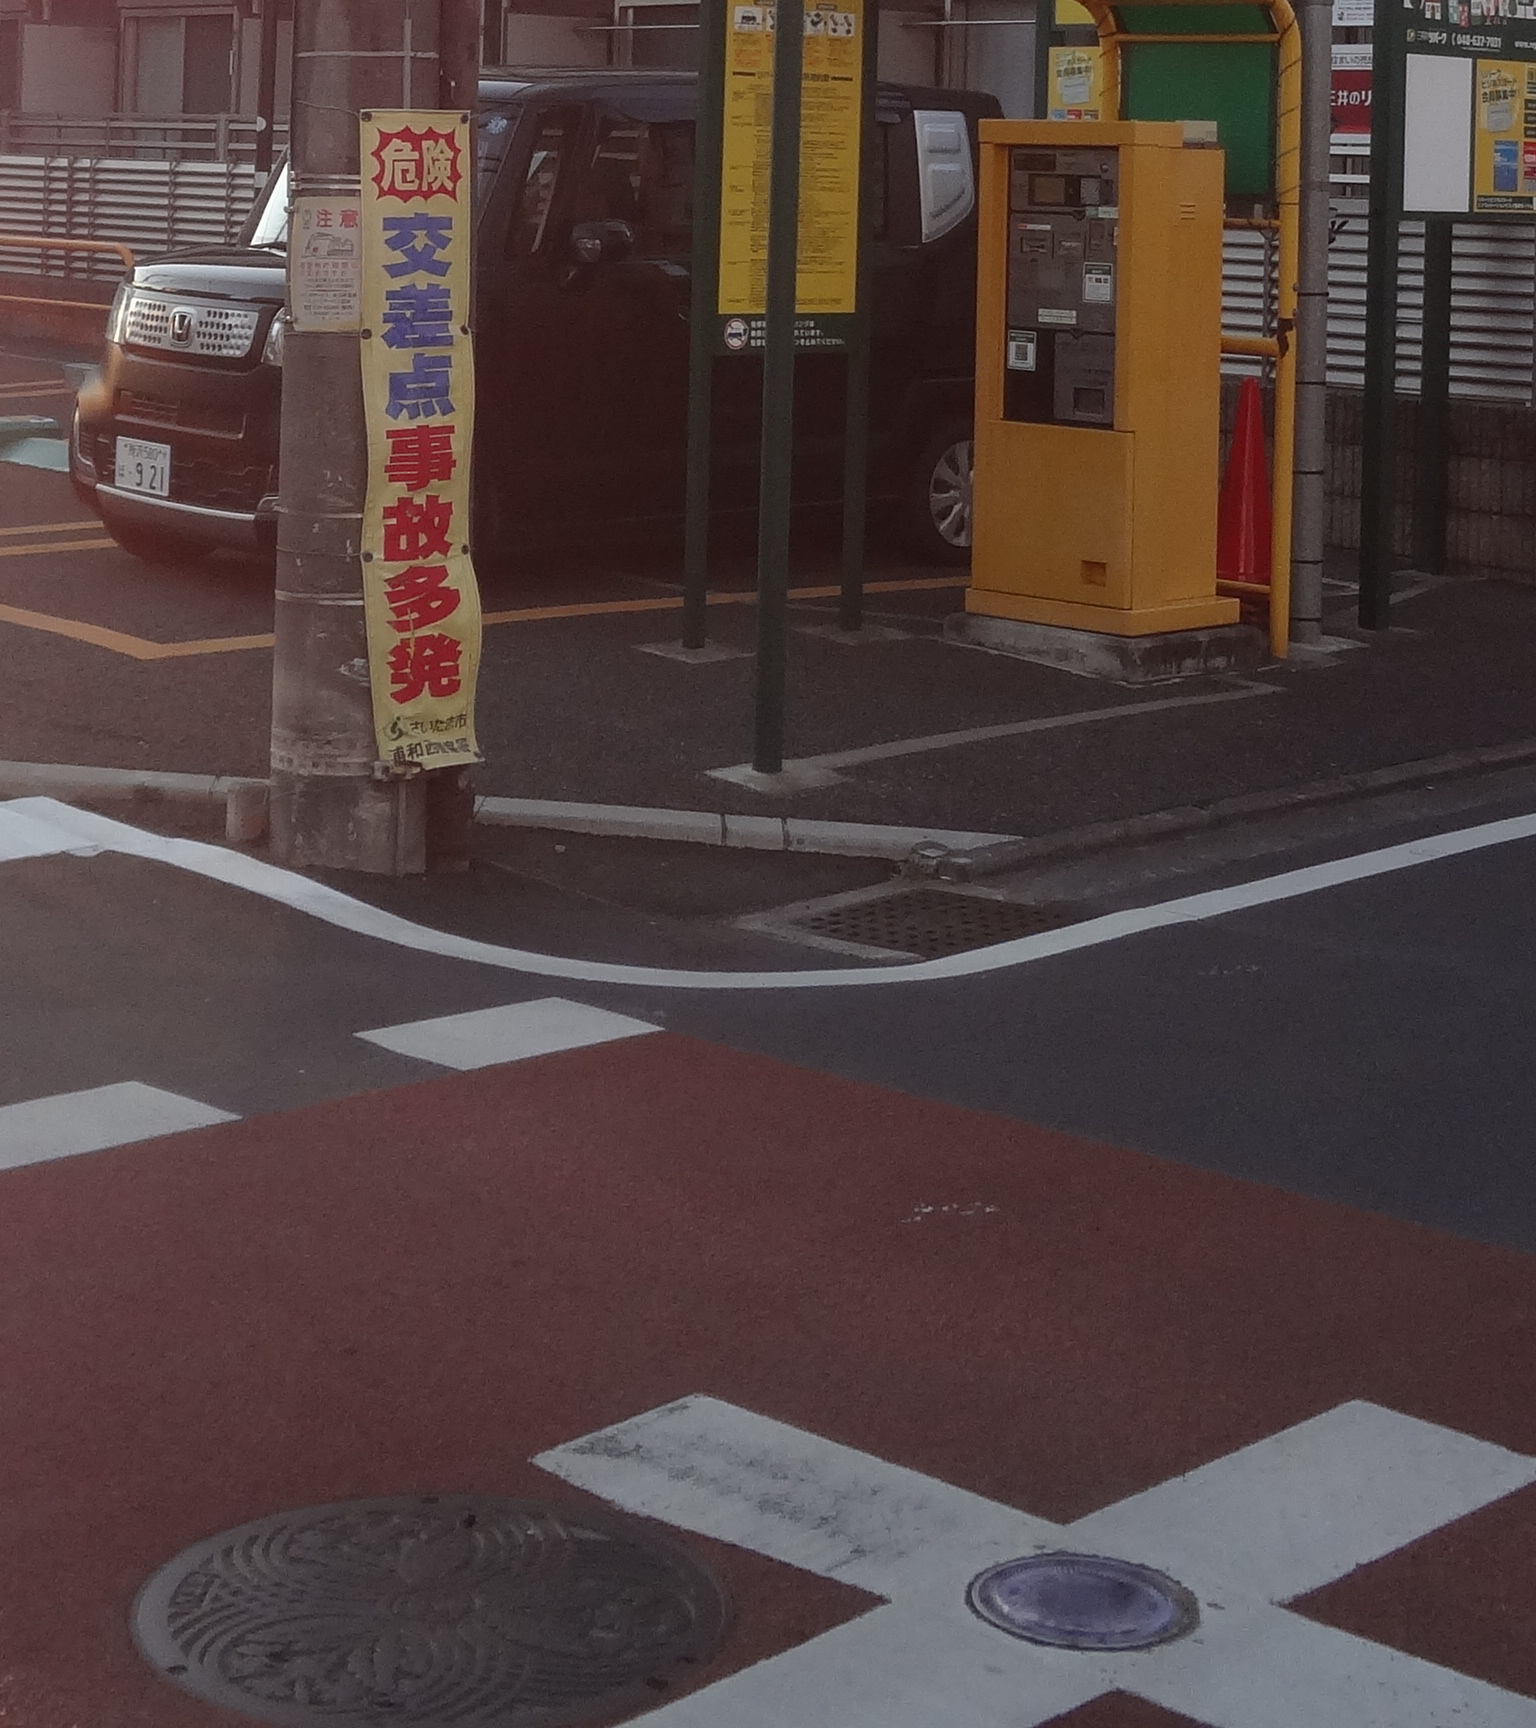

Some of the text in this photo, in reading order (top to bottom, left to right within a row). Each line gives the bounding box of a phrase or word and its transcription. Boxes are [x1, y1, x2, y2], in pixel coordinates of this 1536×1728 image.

[380, 138, 454, 192] 危険
[316, 208, 358, 228] 注意
[381, 212, 462, 704] 交差点事故多発
